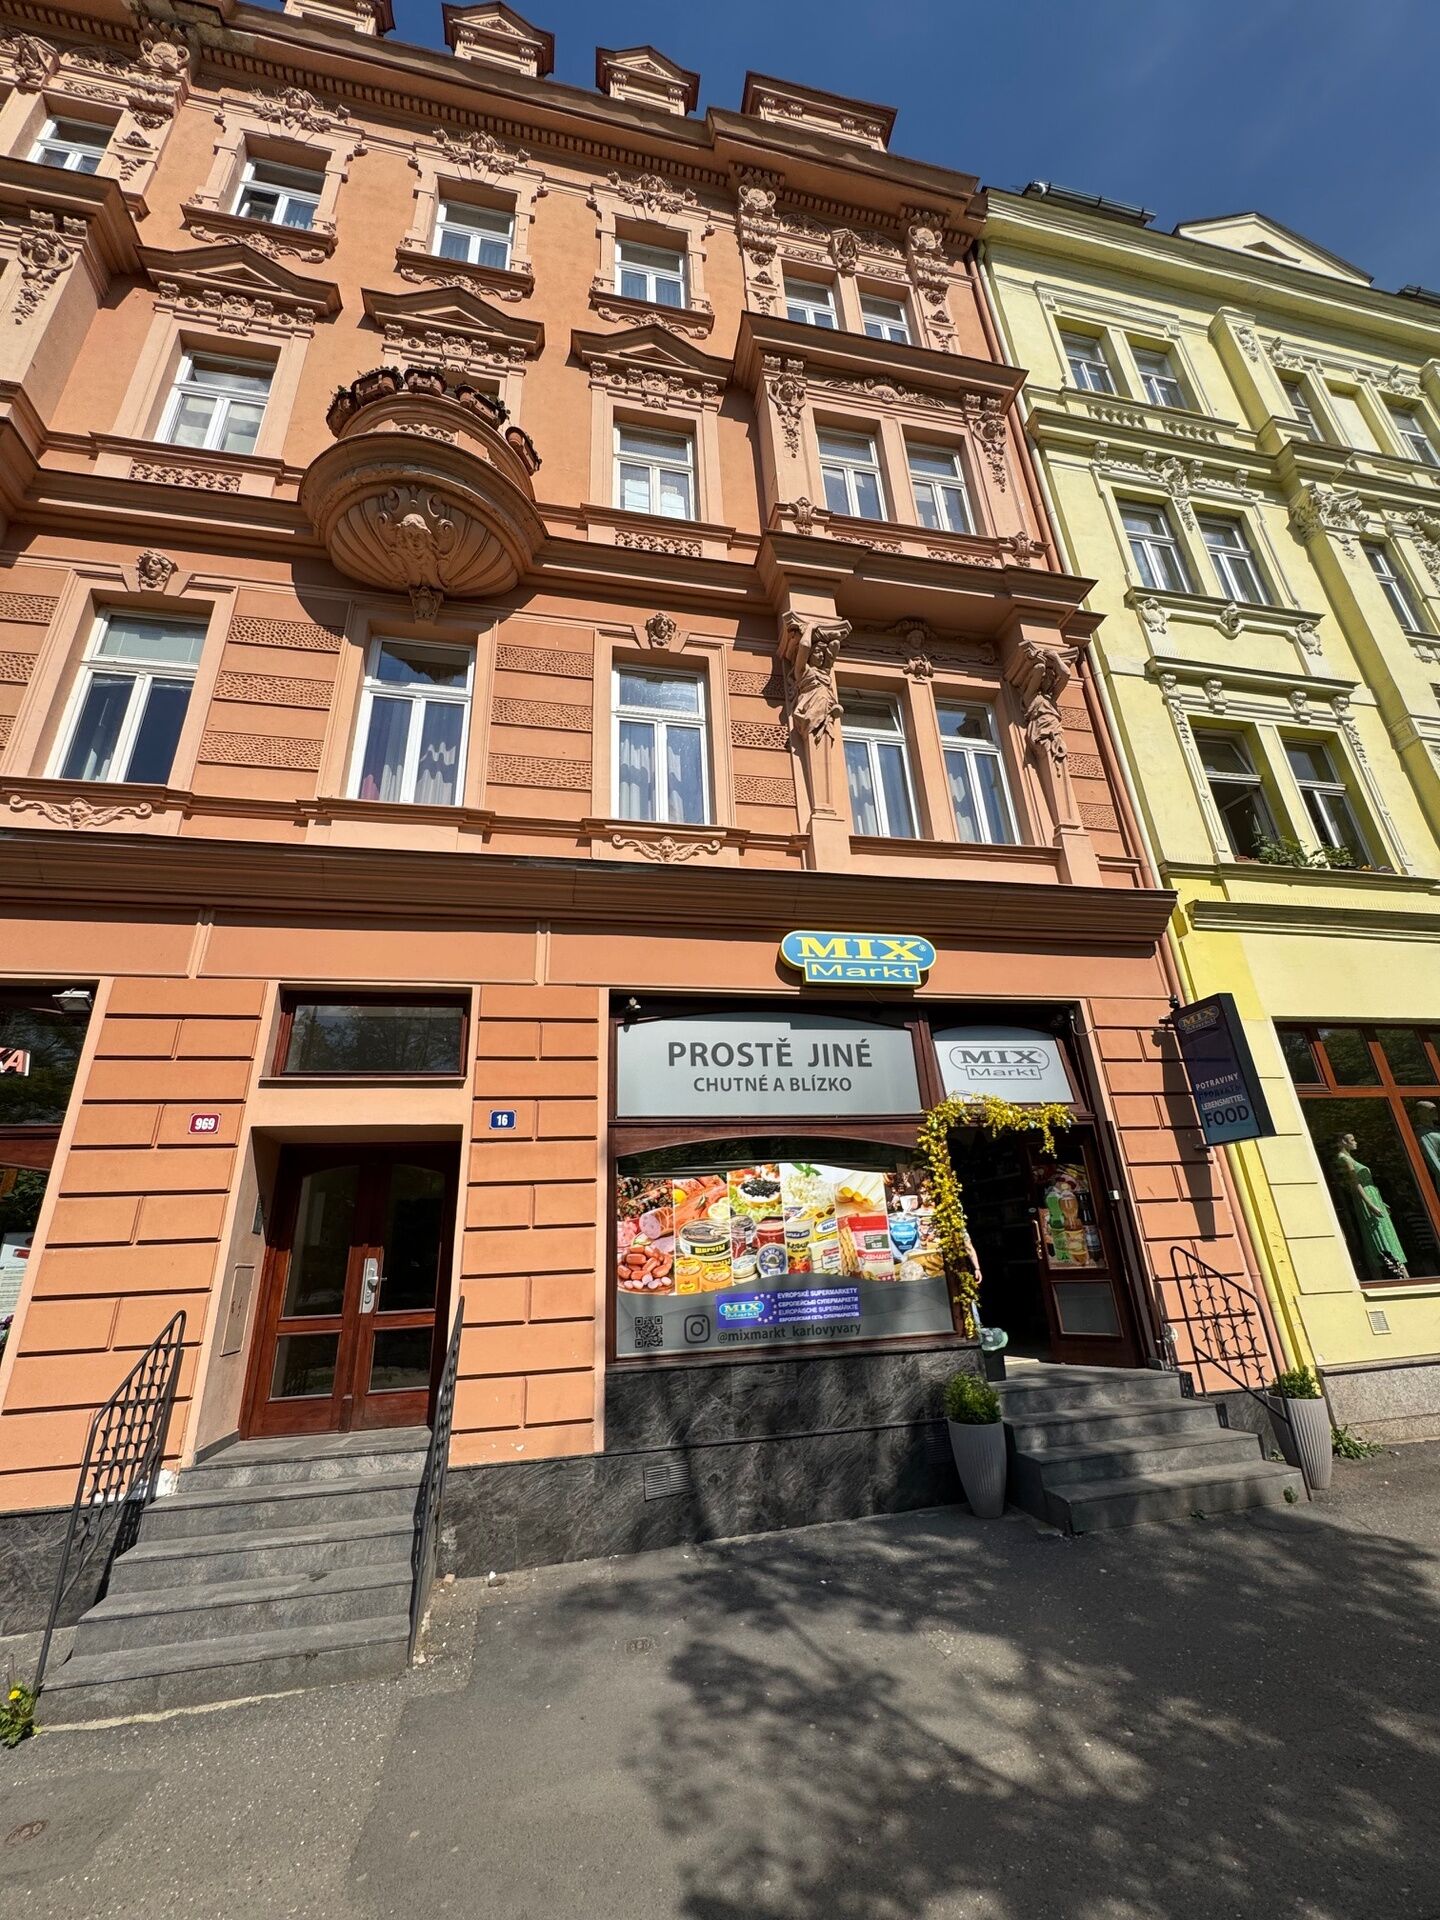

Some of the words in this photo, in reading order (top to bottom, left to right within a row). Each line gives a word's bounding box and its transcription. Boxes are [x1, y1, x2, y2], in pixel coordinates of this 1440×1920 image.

[796, 936, 924, 961] MIX
[811, 963, 914, 979] Markt
[1183, 1008, 1216, 1026] MIX
[668, 1037, 793, 1067] PROSTĚ
[808, 1038, 873, 1068] JINÉ
[958, 1050, 1041, 1064] MIX
[970, 1068, 1038, 1076] Markt
[693, 1074, 769, 1092] CHUTNÉ
[773, 1077, 786, 1092] A
[790, 1074, 852, 1092] BLÍZKO
[1195, 1072, 1239, 1091] POTRAVINY
[1201, 1094, 1246, 1111] LEBENSMITTEL
[195, 1117, 215, 1130] 969
[496, 1114, 509, 1126] 16
[1204, 1104, 1250, 1129] FOOD
[810, 1288, 858, 1297] SUPERMARKETY
[724, 1303, 760, 1312] MIX
[717, 1323, 862, 1343] @mixmarkt_karlovyvary
